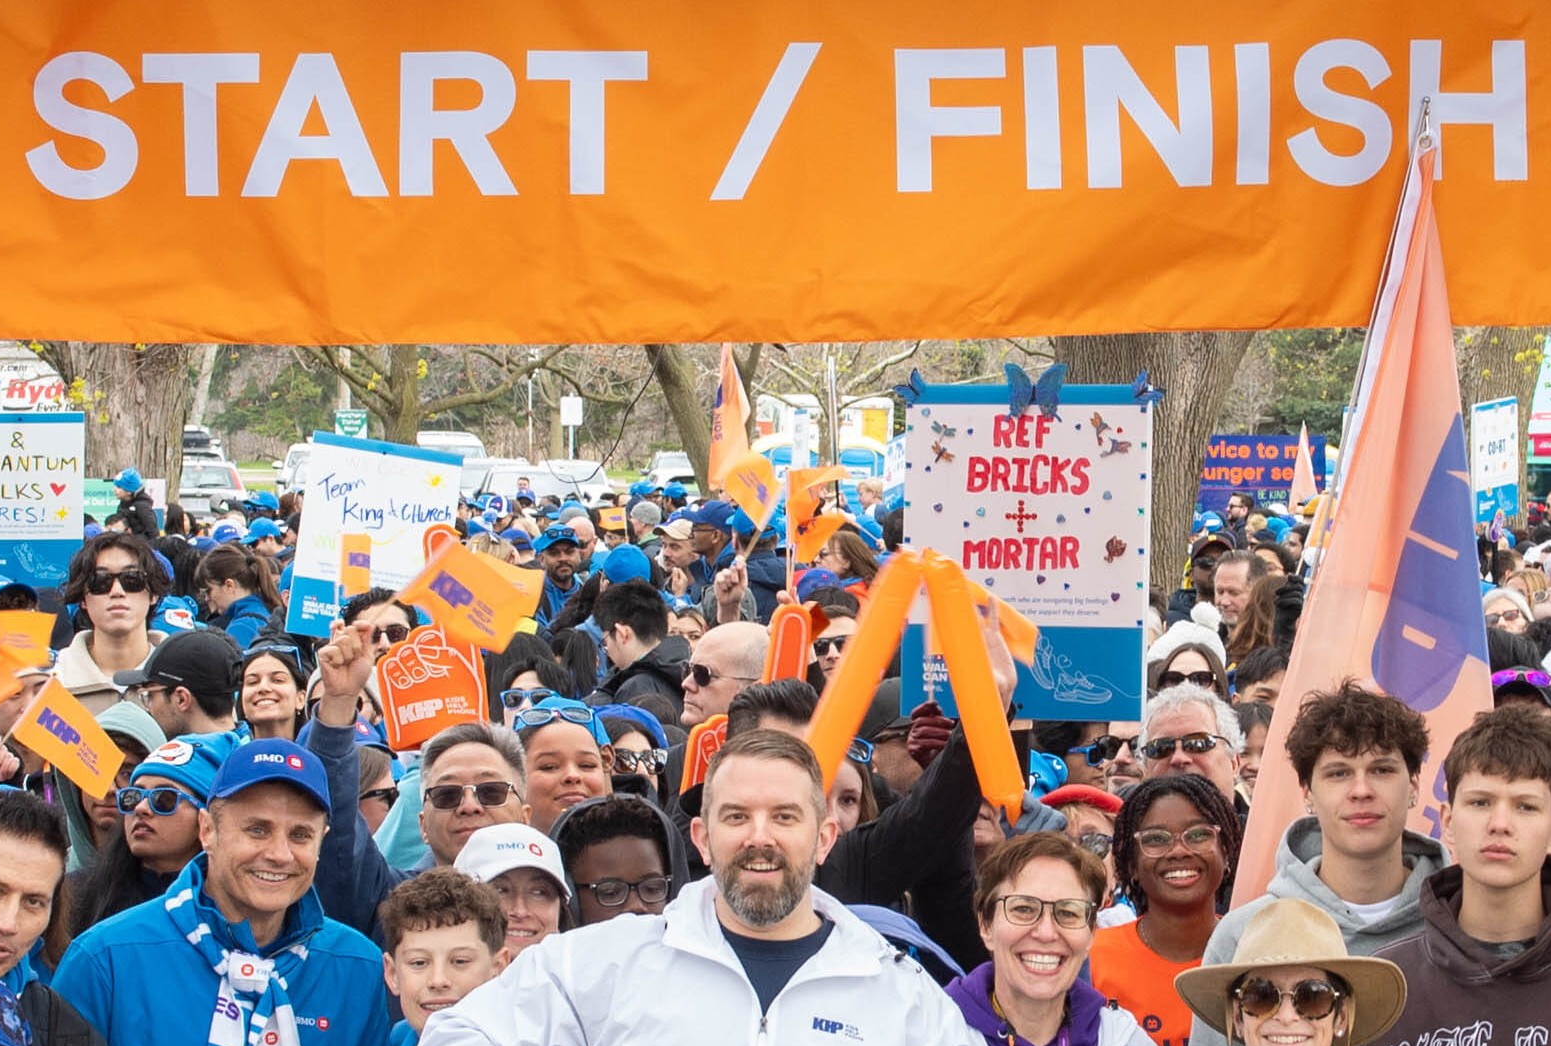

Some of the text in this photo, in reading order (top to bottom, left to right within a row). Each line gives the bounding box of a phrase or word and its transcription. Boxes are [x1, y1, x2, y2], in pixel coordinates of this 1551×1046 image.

[25, 38, 1530, 201] START / FINISH
[10, 430, 25, 451] &
[993, 414, 1055, 449] REF
[1256, 442, 1280, 459] to
[317, 472, 367, 502] Team
[966, 454, 1091, 496] BRICKS
[342, 496, 384, 530] King
[962, 535, 1080, 571] MORTAR
[922, 663, 949, 673] WAL
[36, 706, 82, 746] KHP
[398, 698, 444, 726] KHP
[253, 753, 285, 764] BMO
[812, 1017, 844, 1035] KHP
